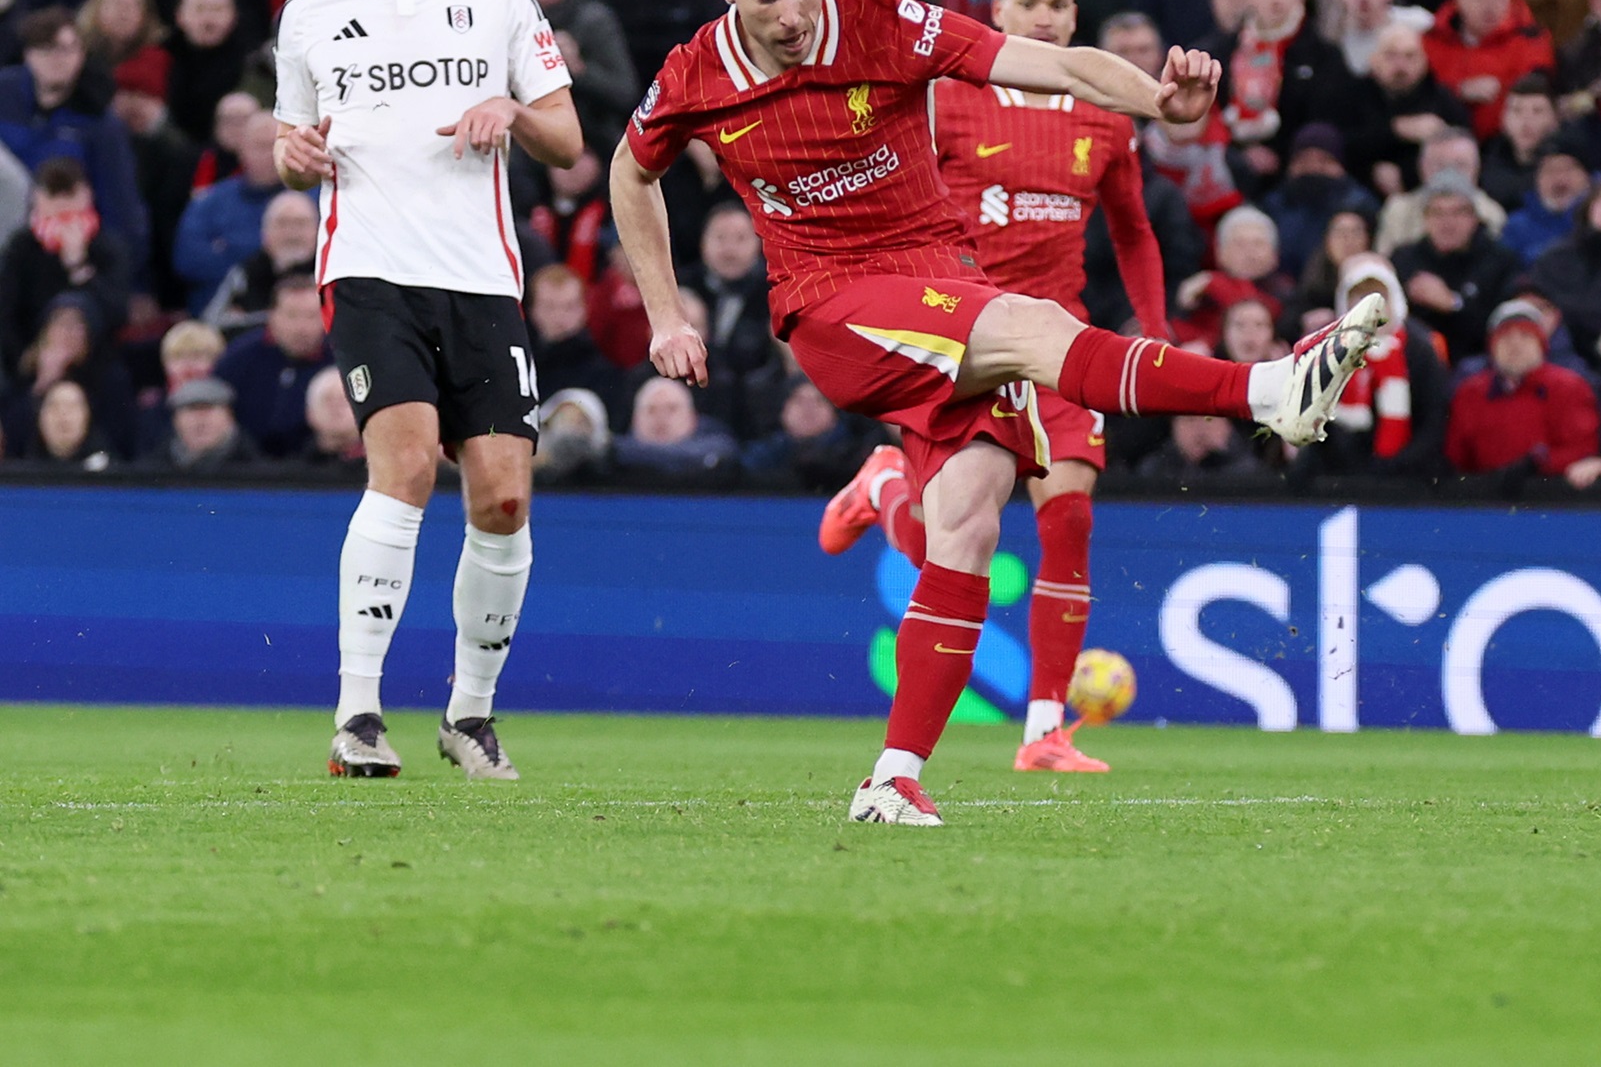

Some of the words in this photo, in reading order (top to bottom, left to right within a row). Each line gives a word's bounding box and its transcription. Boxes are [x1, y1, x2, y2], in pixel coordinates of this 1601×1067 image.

[369, 58, 489, 93] SBOTOP
[788, 143, 890, 195] standard
[796, 151, 900, 207] chartered
[357, 574, 403, 591] FFC
